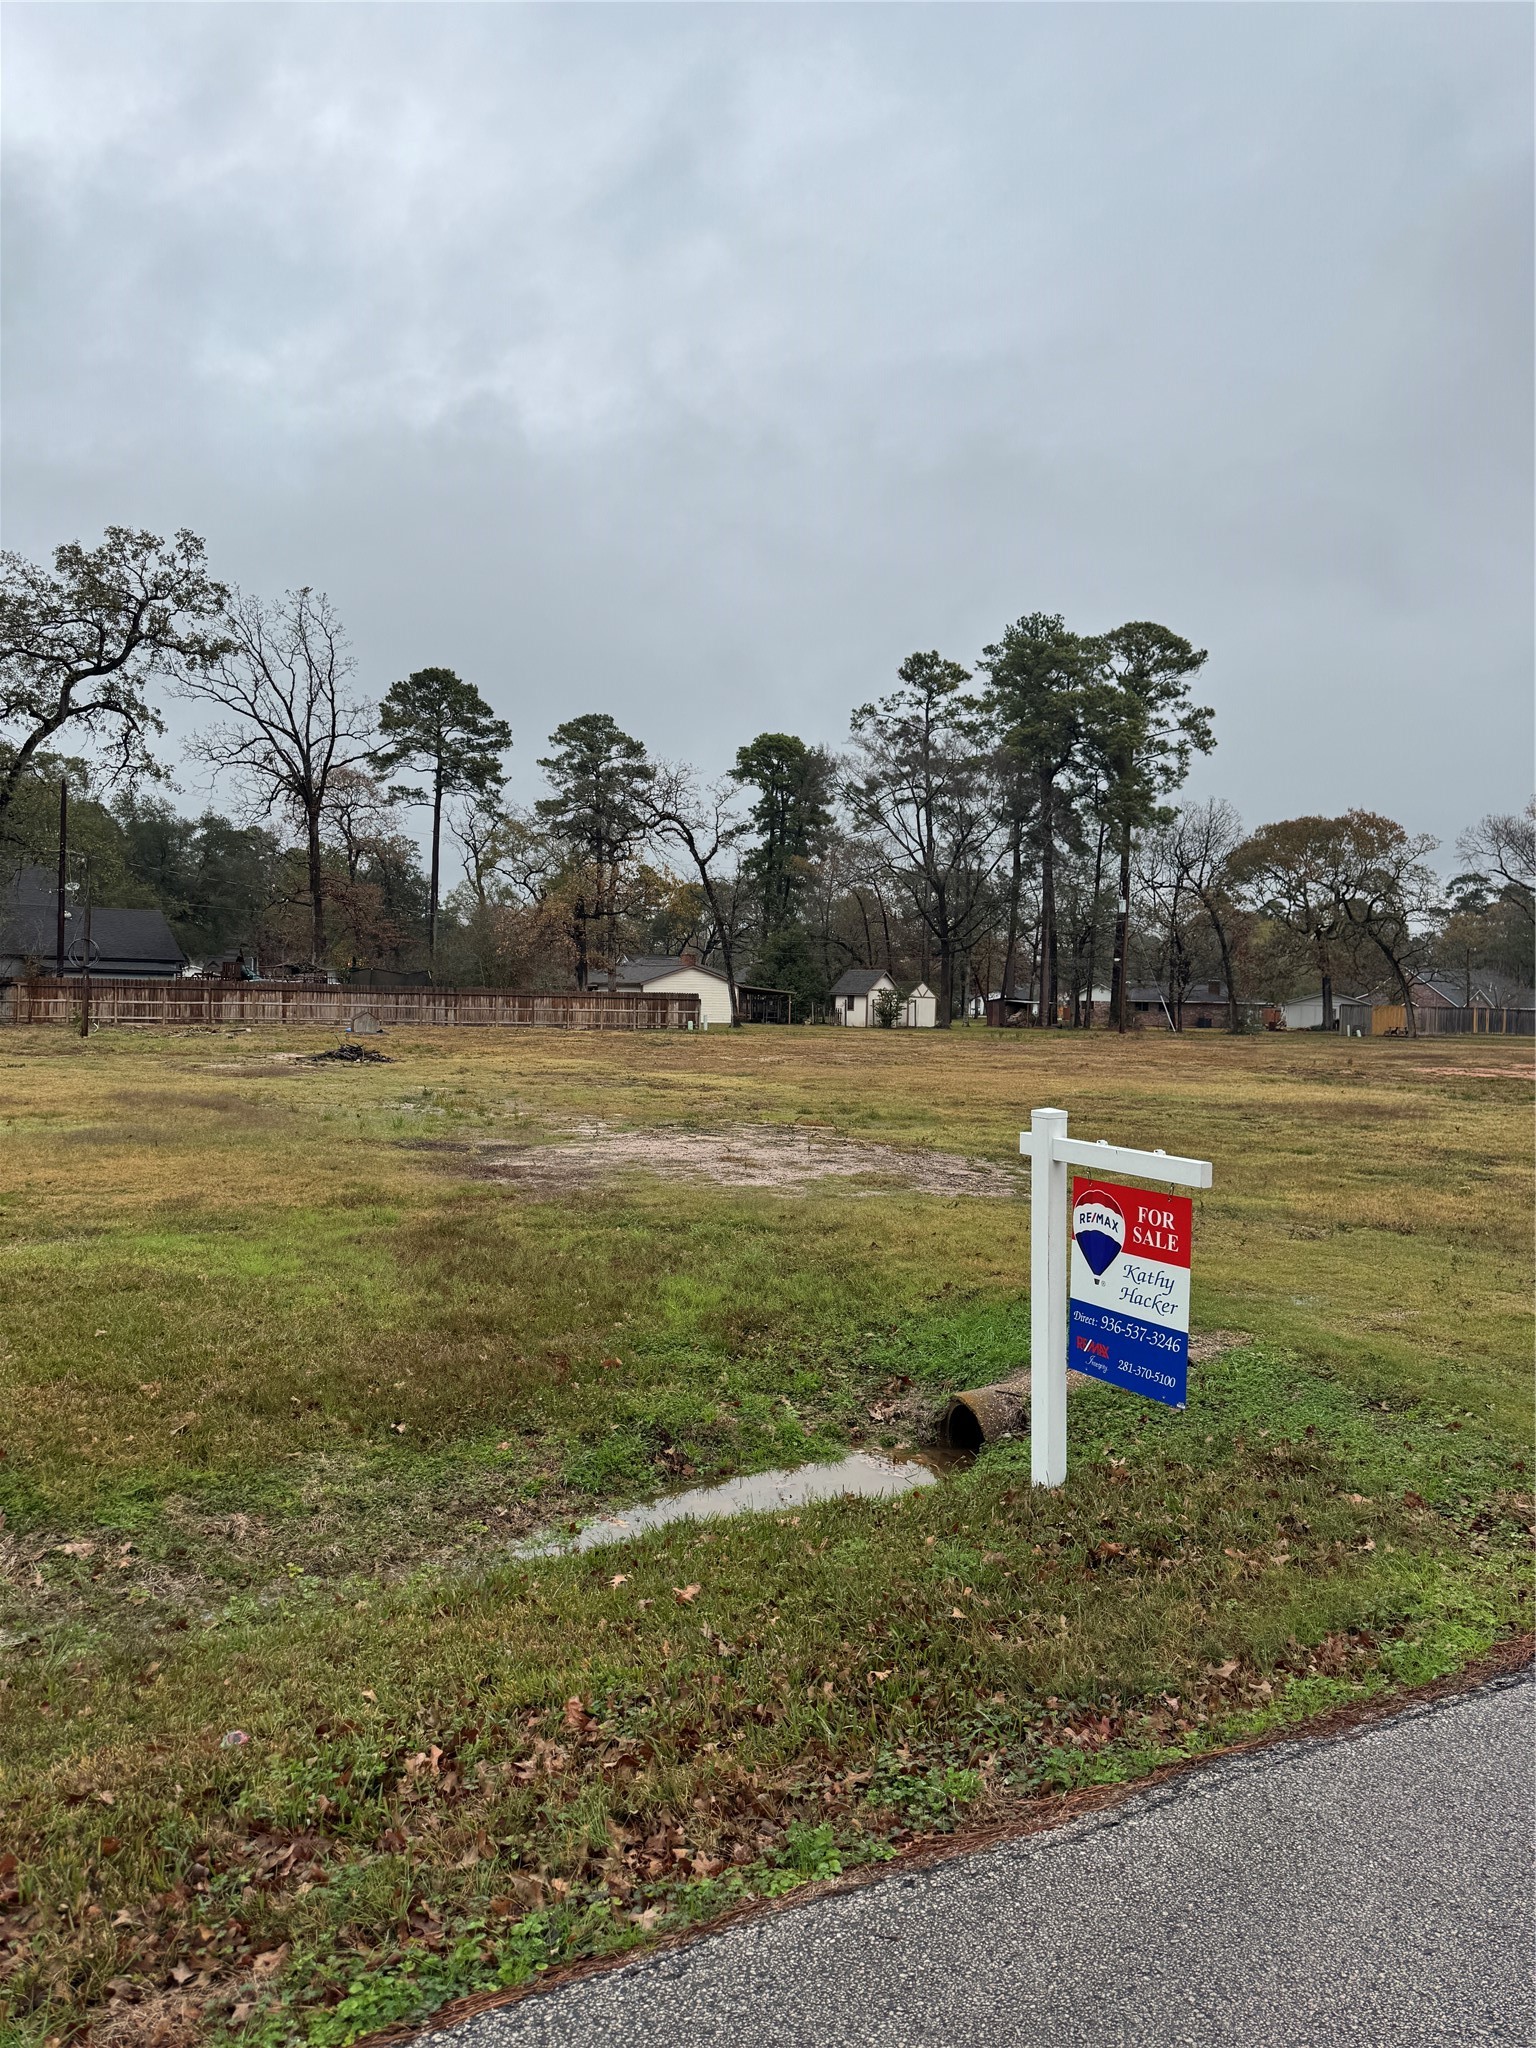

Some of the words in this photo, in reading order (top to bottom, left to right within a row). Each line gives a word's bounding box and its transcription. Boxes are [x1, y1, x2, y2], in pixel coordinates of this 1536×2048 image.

[1079, 1212, 1119, 1233] RE/MAX
[1137, 1206, 1176, 1230] FOR
[1132, 1226, 1179, 1252] SALE
[1122, 1264, 1175, 1295] Kathy
[1118, 1287, 1179, 1316] Hacker
[1073, 1310, 1099, 1327] Direct:
[1100, 1315, 1182, 1353] 936-537-3246
[1117, 1359, 1176, 1388] 281-370-5100
